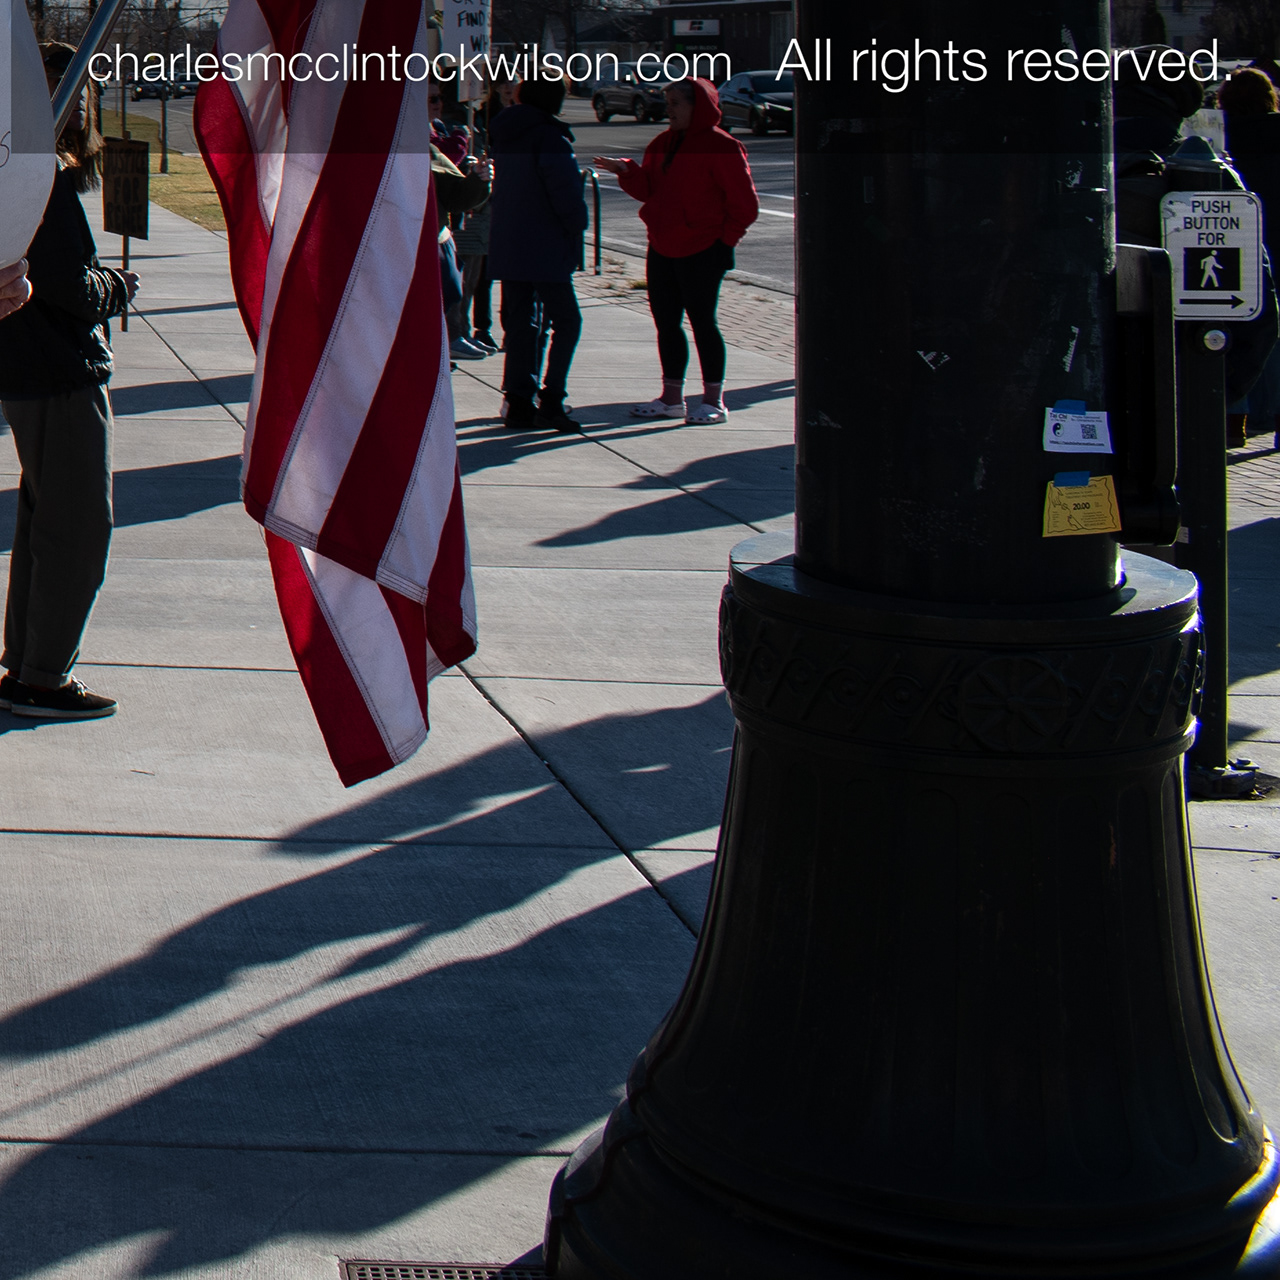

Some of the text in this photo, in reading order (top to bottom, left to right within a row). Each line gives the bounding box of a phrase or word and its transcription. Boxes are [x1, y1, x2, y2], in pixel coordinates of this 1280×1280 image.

[1191, 200, 1231, 214] PUSH
[1183, 216, 1239, 231] BUTTON
[1197, 232, 1226, 246] FOR
